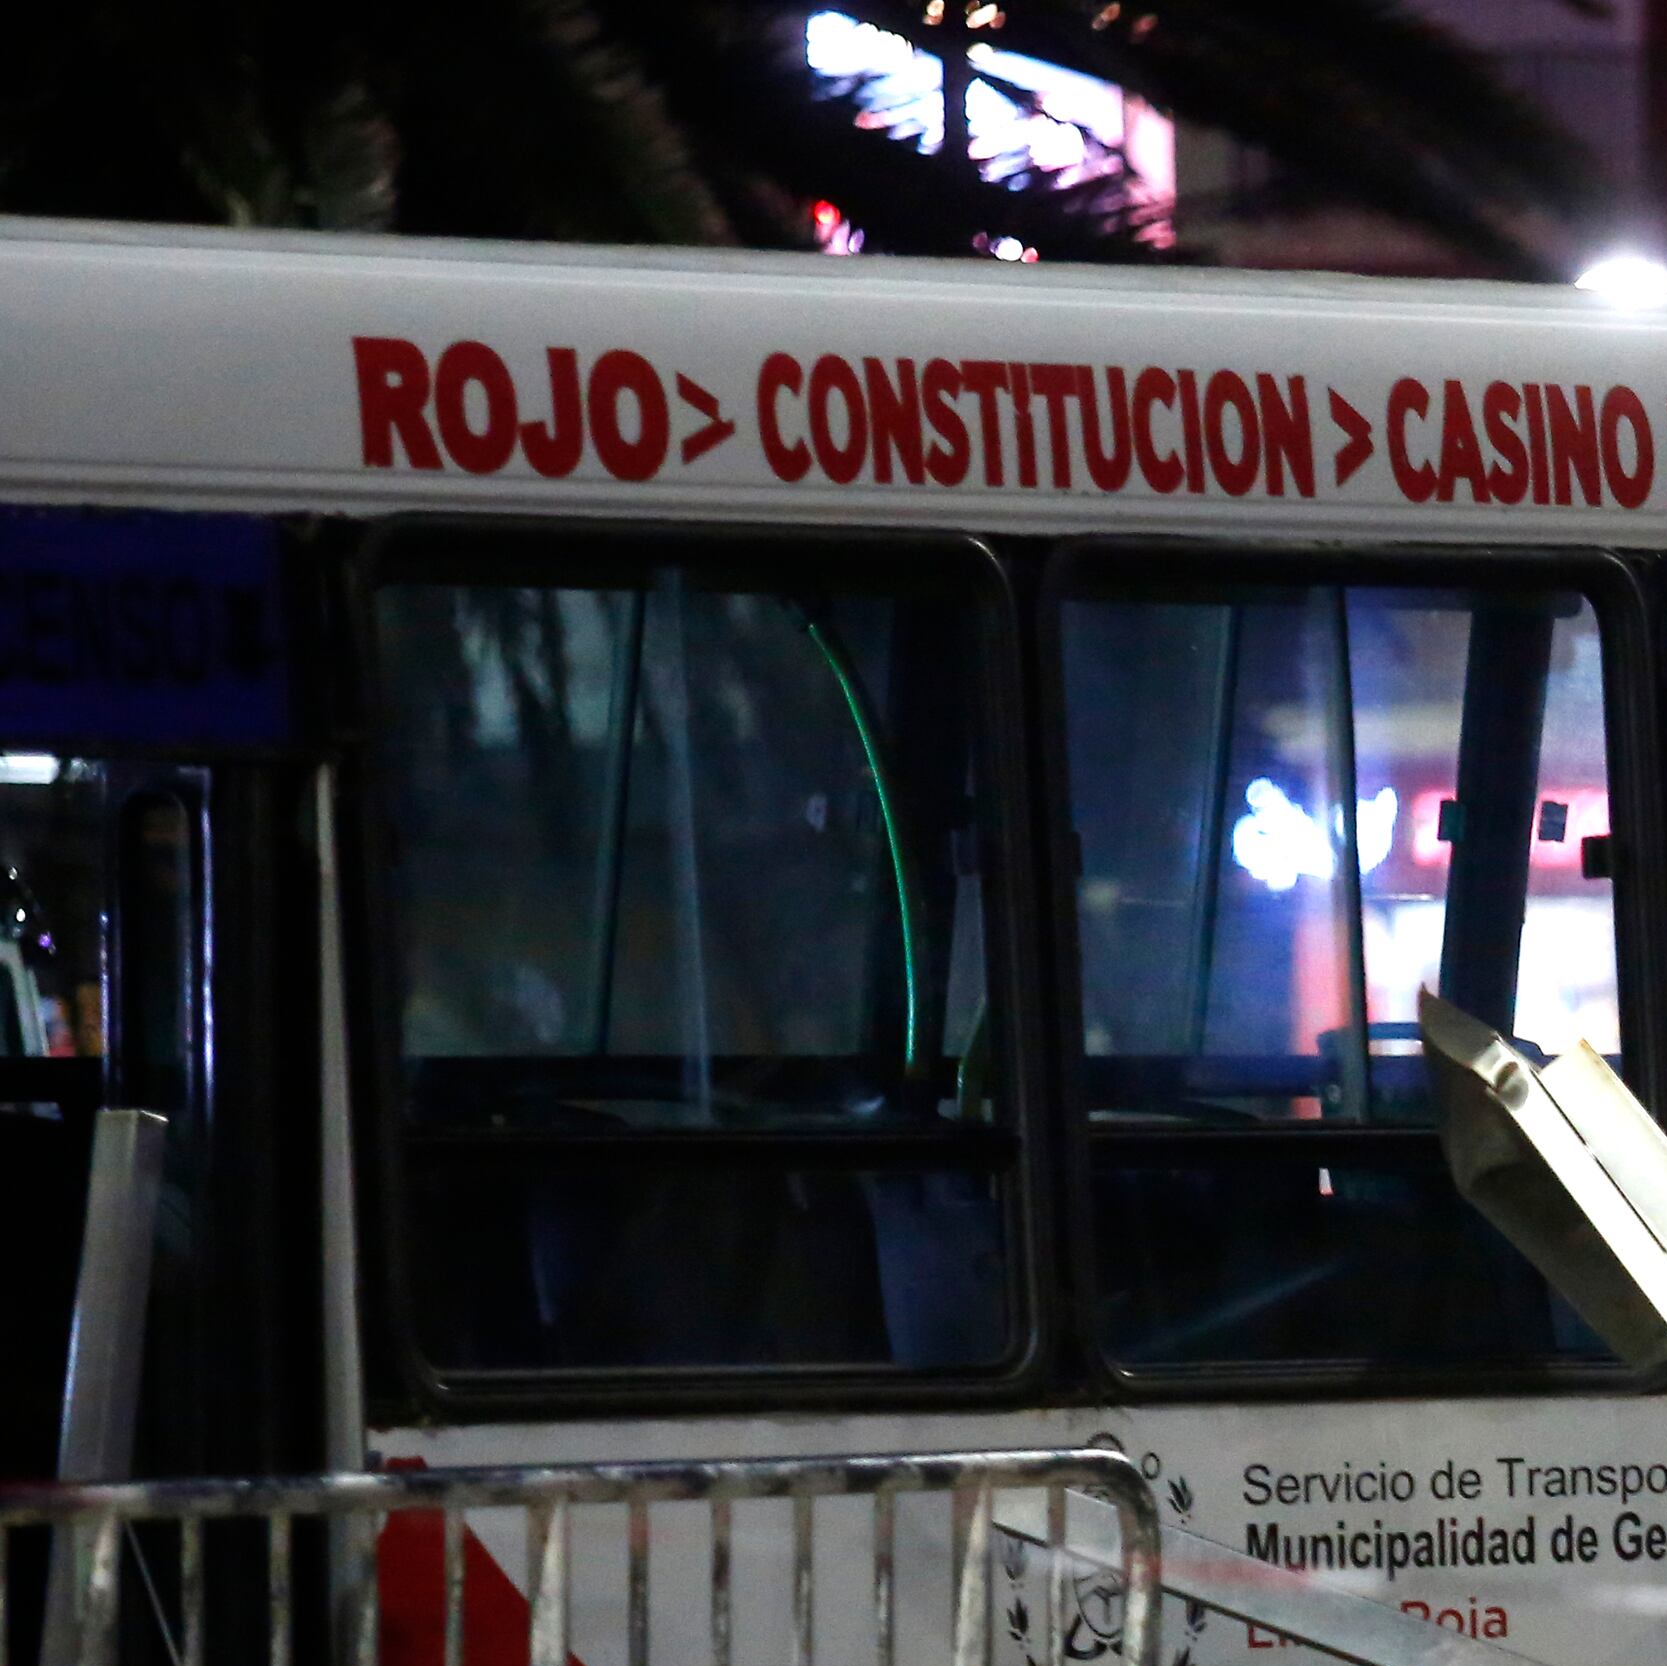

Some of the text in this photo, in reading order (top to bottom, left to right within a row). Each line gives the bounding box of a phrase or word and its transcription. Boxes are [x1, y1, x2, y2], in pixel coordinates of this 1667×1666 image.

[353, 337, 668, 479] ROJO
[758, 353, 1313, 495] CONSTITUCION
[1388, 379, 1653, 508] CASINO
[1243, 1461, 1414, 1506] Servicio
[1431, 1460, 1482, 1498] de
[1246, 1516, 1535, 1581] Municipalidad
[1550, 1515, 1599, 1561] de
